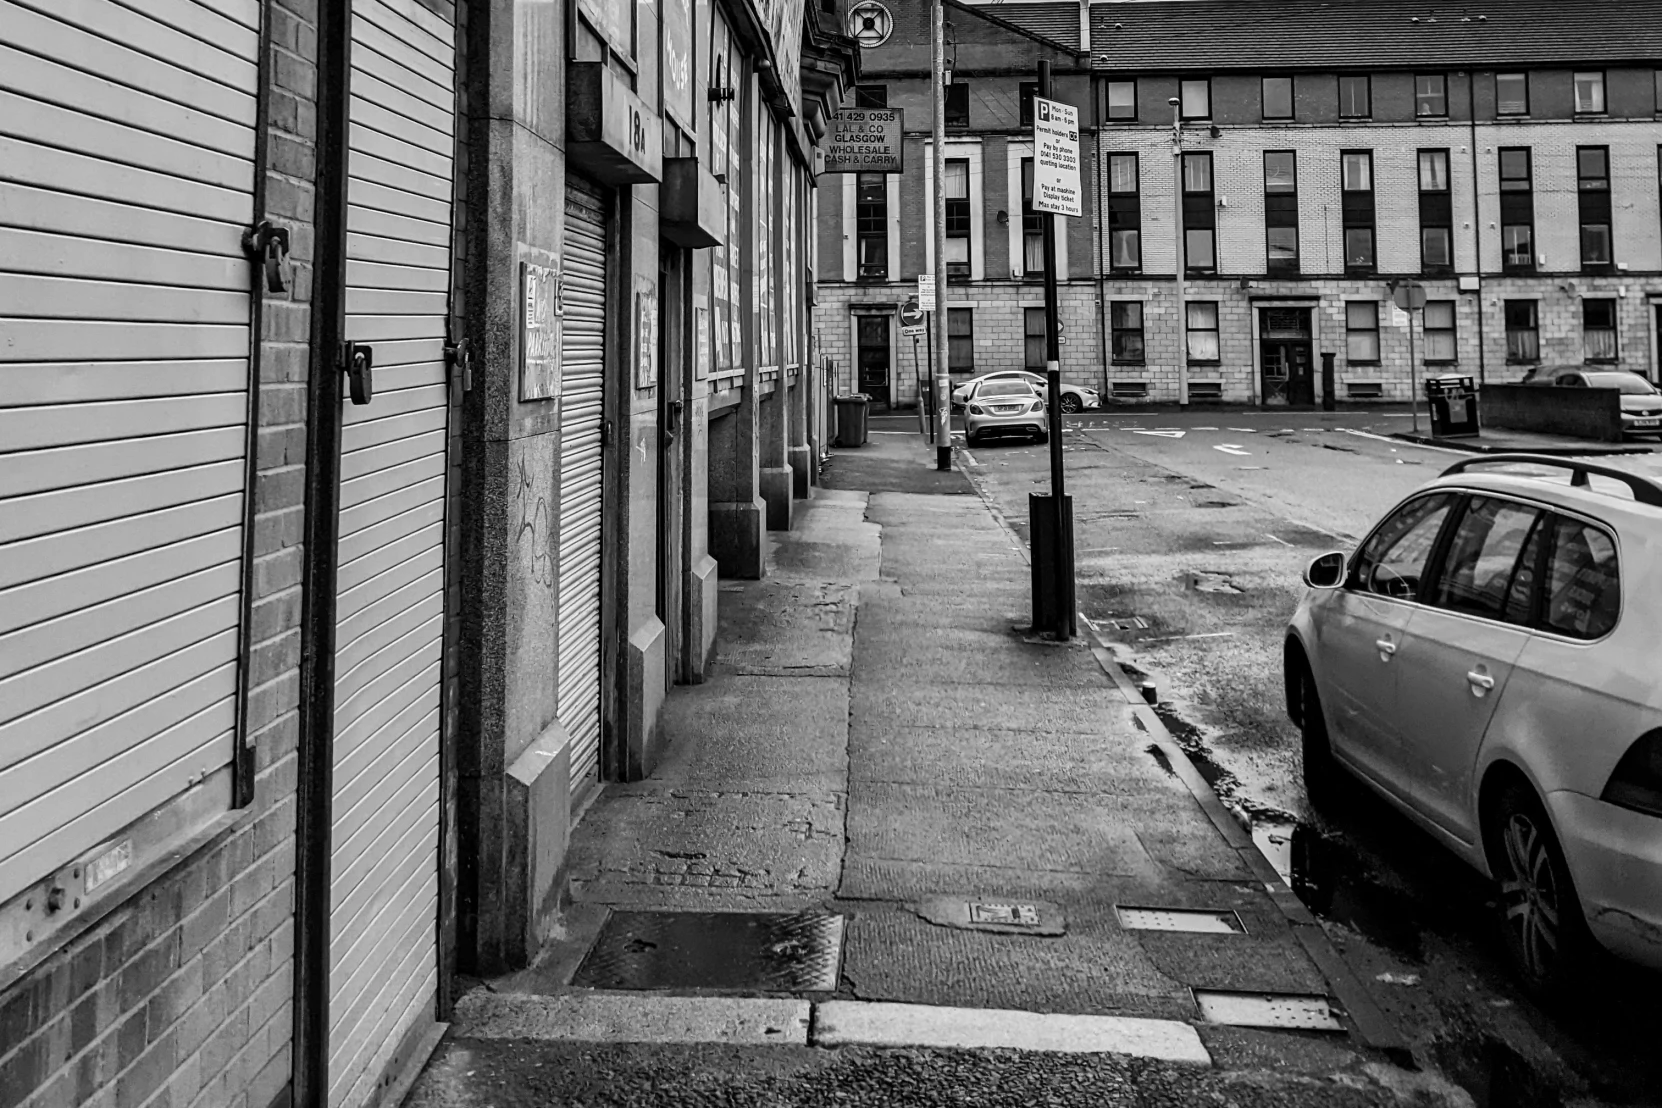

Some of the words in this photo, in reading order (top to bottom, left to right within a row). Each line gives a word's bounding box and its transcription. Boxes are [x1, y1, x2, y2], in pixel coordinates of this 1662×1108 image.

[1041, 103, 1048, 119] P
[847, 113, 865, 121] 429
[869, 113, 895, 121] 0935
[1037, 125, 1051, 134] Permit
[1052, 129, 1068, 138] holders
[835, 135, 886, 143] GLASGOW
[829, 146, 890, 154] WHOLESALE
[1060, 146, 1072, 154] phone
[825, 155, 850, 163] CASH
[853, 155, 859, 163] &
[1040, 160, 1057, 168] quoting
[1059, 163, 1076, 171] location
[1041, 183, 1049, 191] Pay
[1044, 192, 1060, 201] Display
